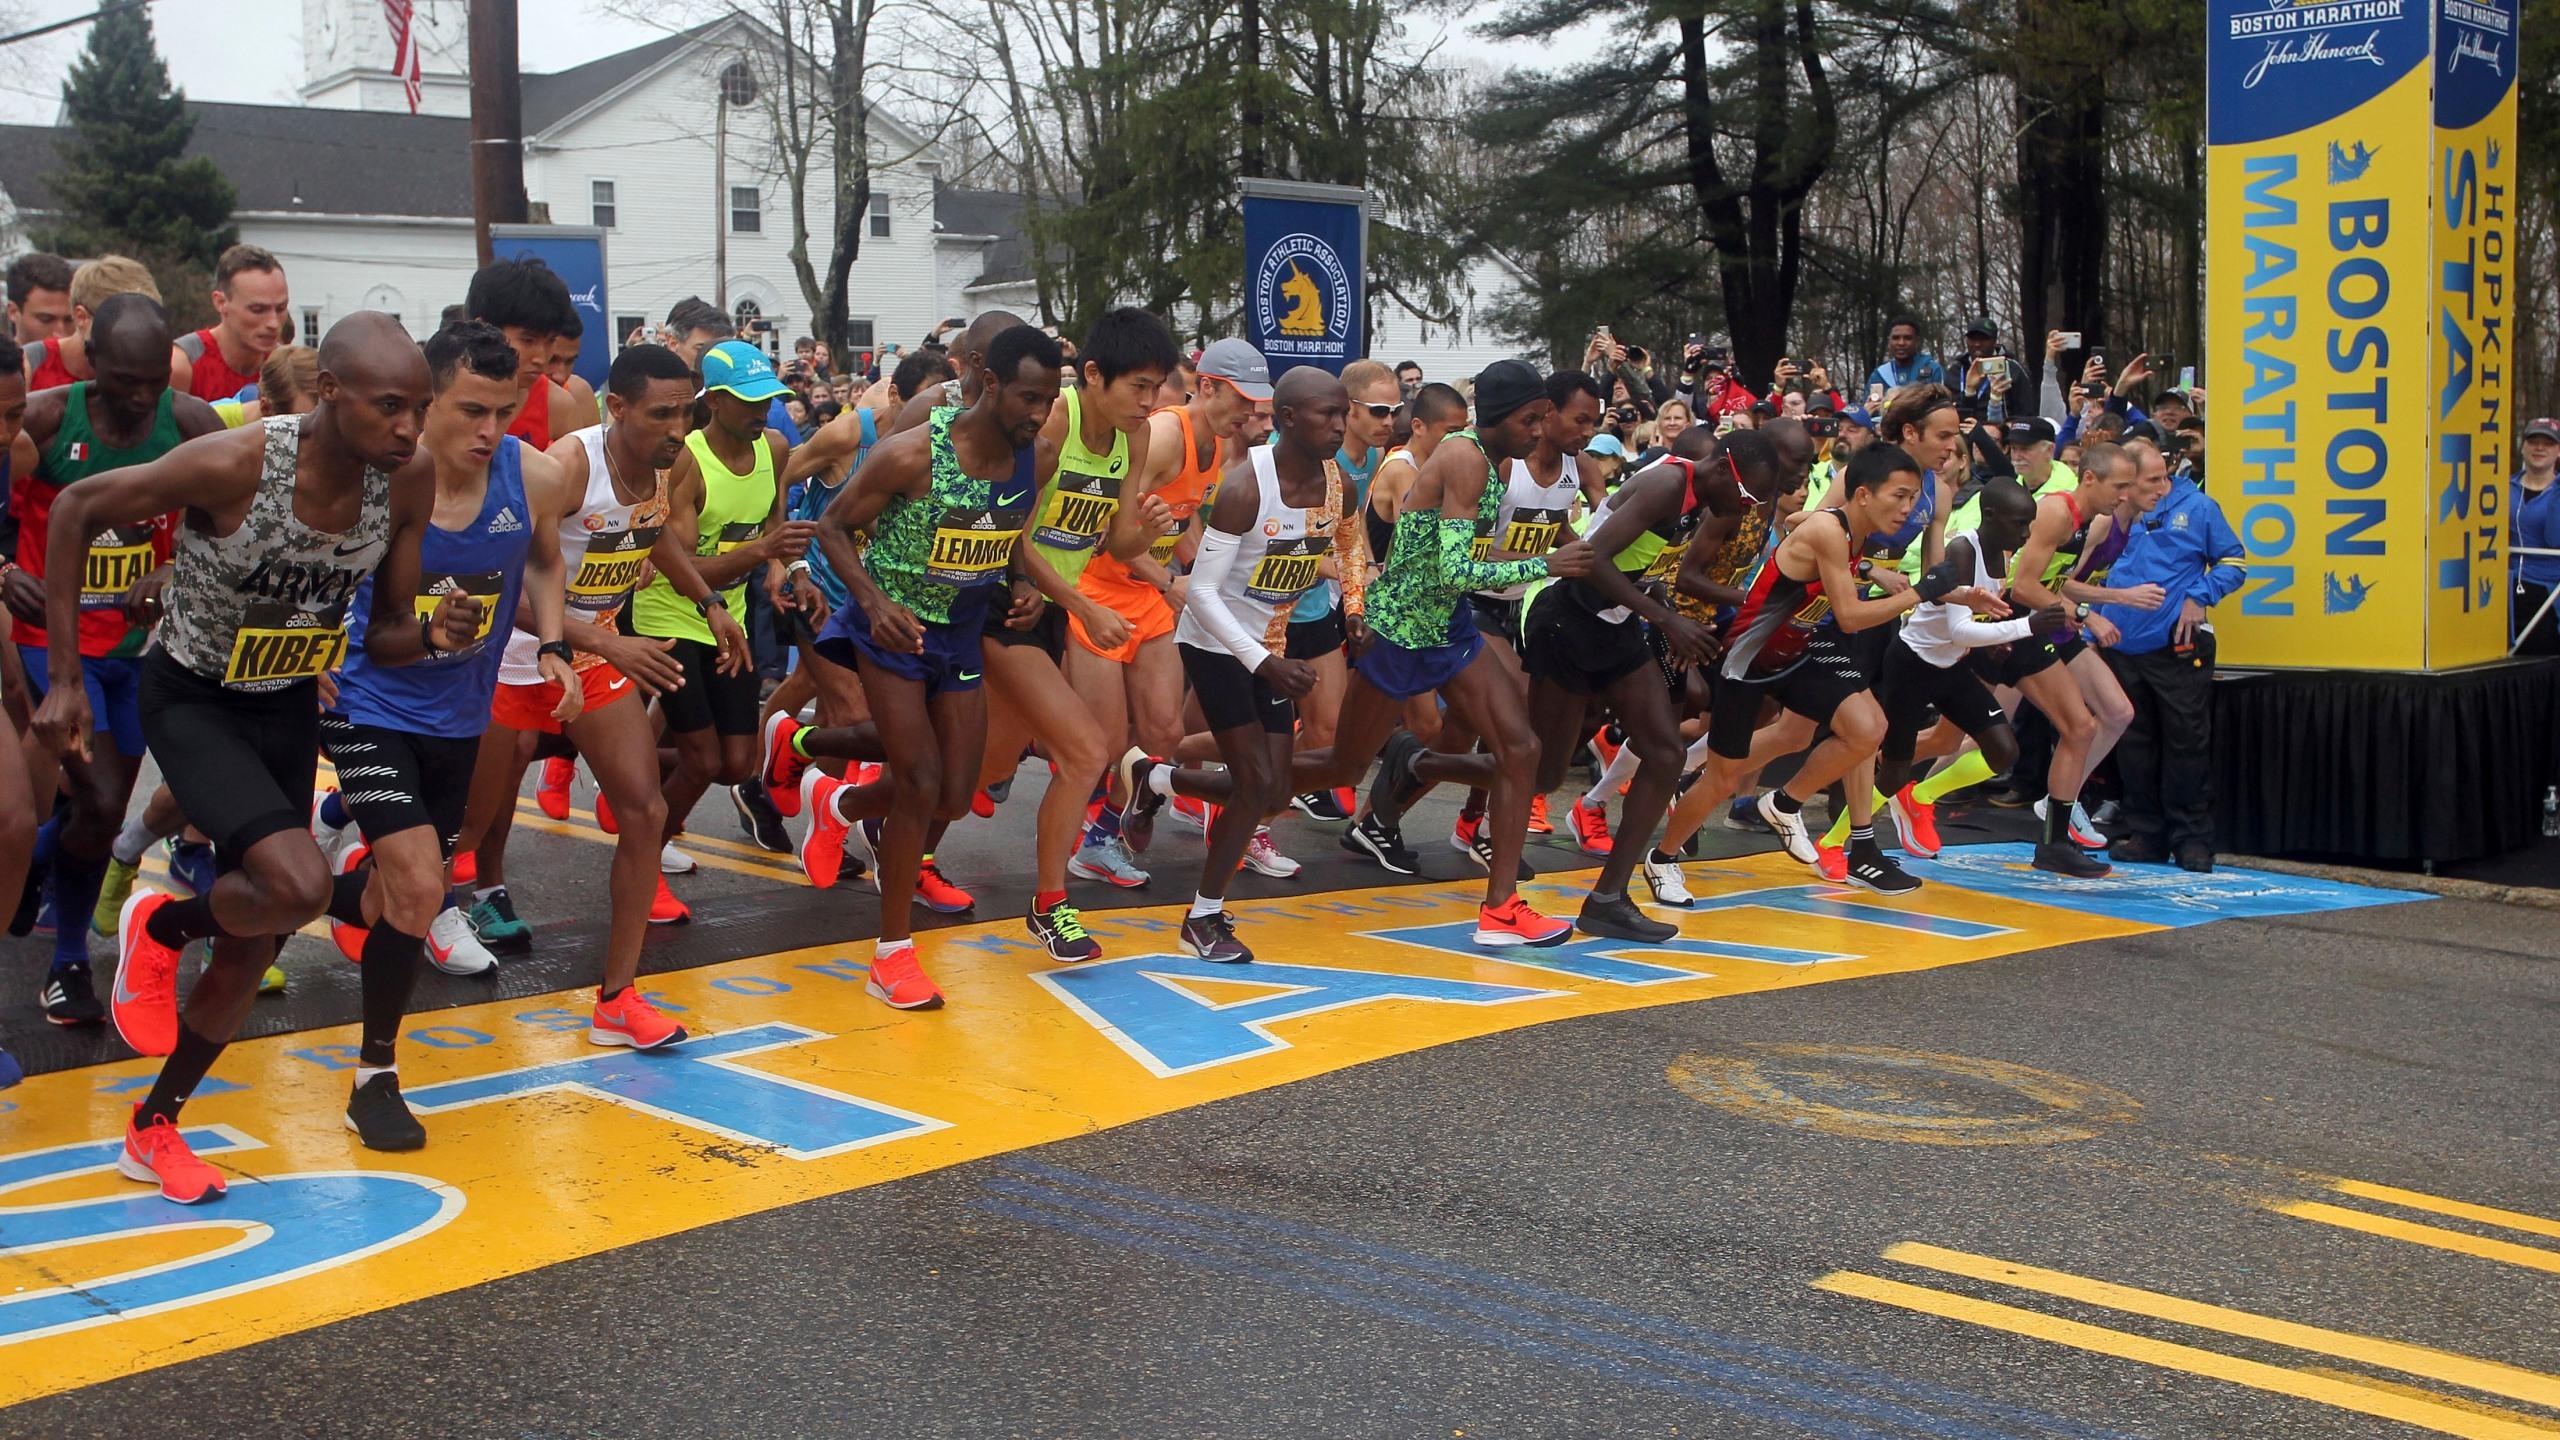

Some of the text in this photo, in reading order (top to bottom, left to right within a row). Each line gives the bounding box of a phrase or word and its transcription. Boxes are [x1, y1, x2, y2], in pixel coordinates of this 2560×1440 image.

[2230, 0, 2401, 35] BOSTON MARATHON
[2444, 0, 2509, 31] BOSTON MARATHON
[2243, 29, 2385, 89] John Hancock
[1260, 238, 1347, 329] BOSTON ATHLETIC ASSOCIATION
[1263, 339, 1344, 353] BOSTON MARATHON
[2241, 154, 2297, 616] MARATHON
[2325, 198, 2390, 555] BOSTON
[2438, 146, 2477, 613] START
[2478, 183, 2504, 562] HOPKINTON
[1081, 487, 1103, 496] adidas
[488, 522, 523, 533] adidas
[1055, 496, 1113, 534] YUKI
[933, 537, 1012, 565] LEMMA
[236, 561, 367, 603] ARMY
[233, 632, 346, 679] KIBET
[261, 678, 292, 686] BOSTON
